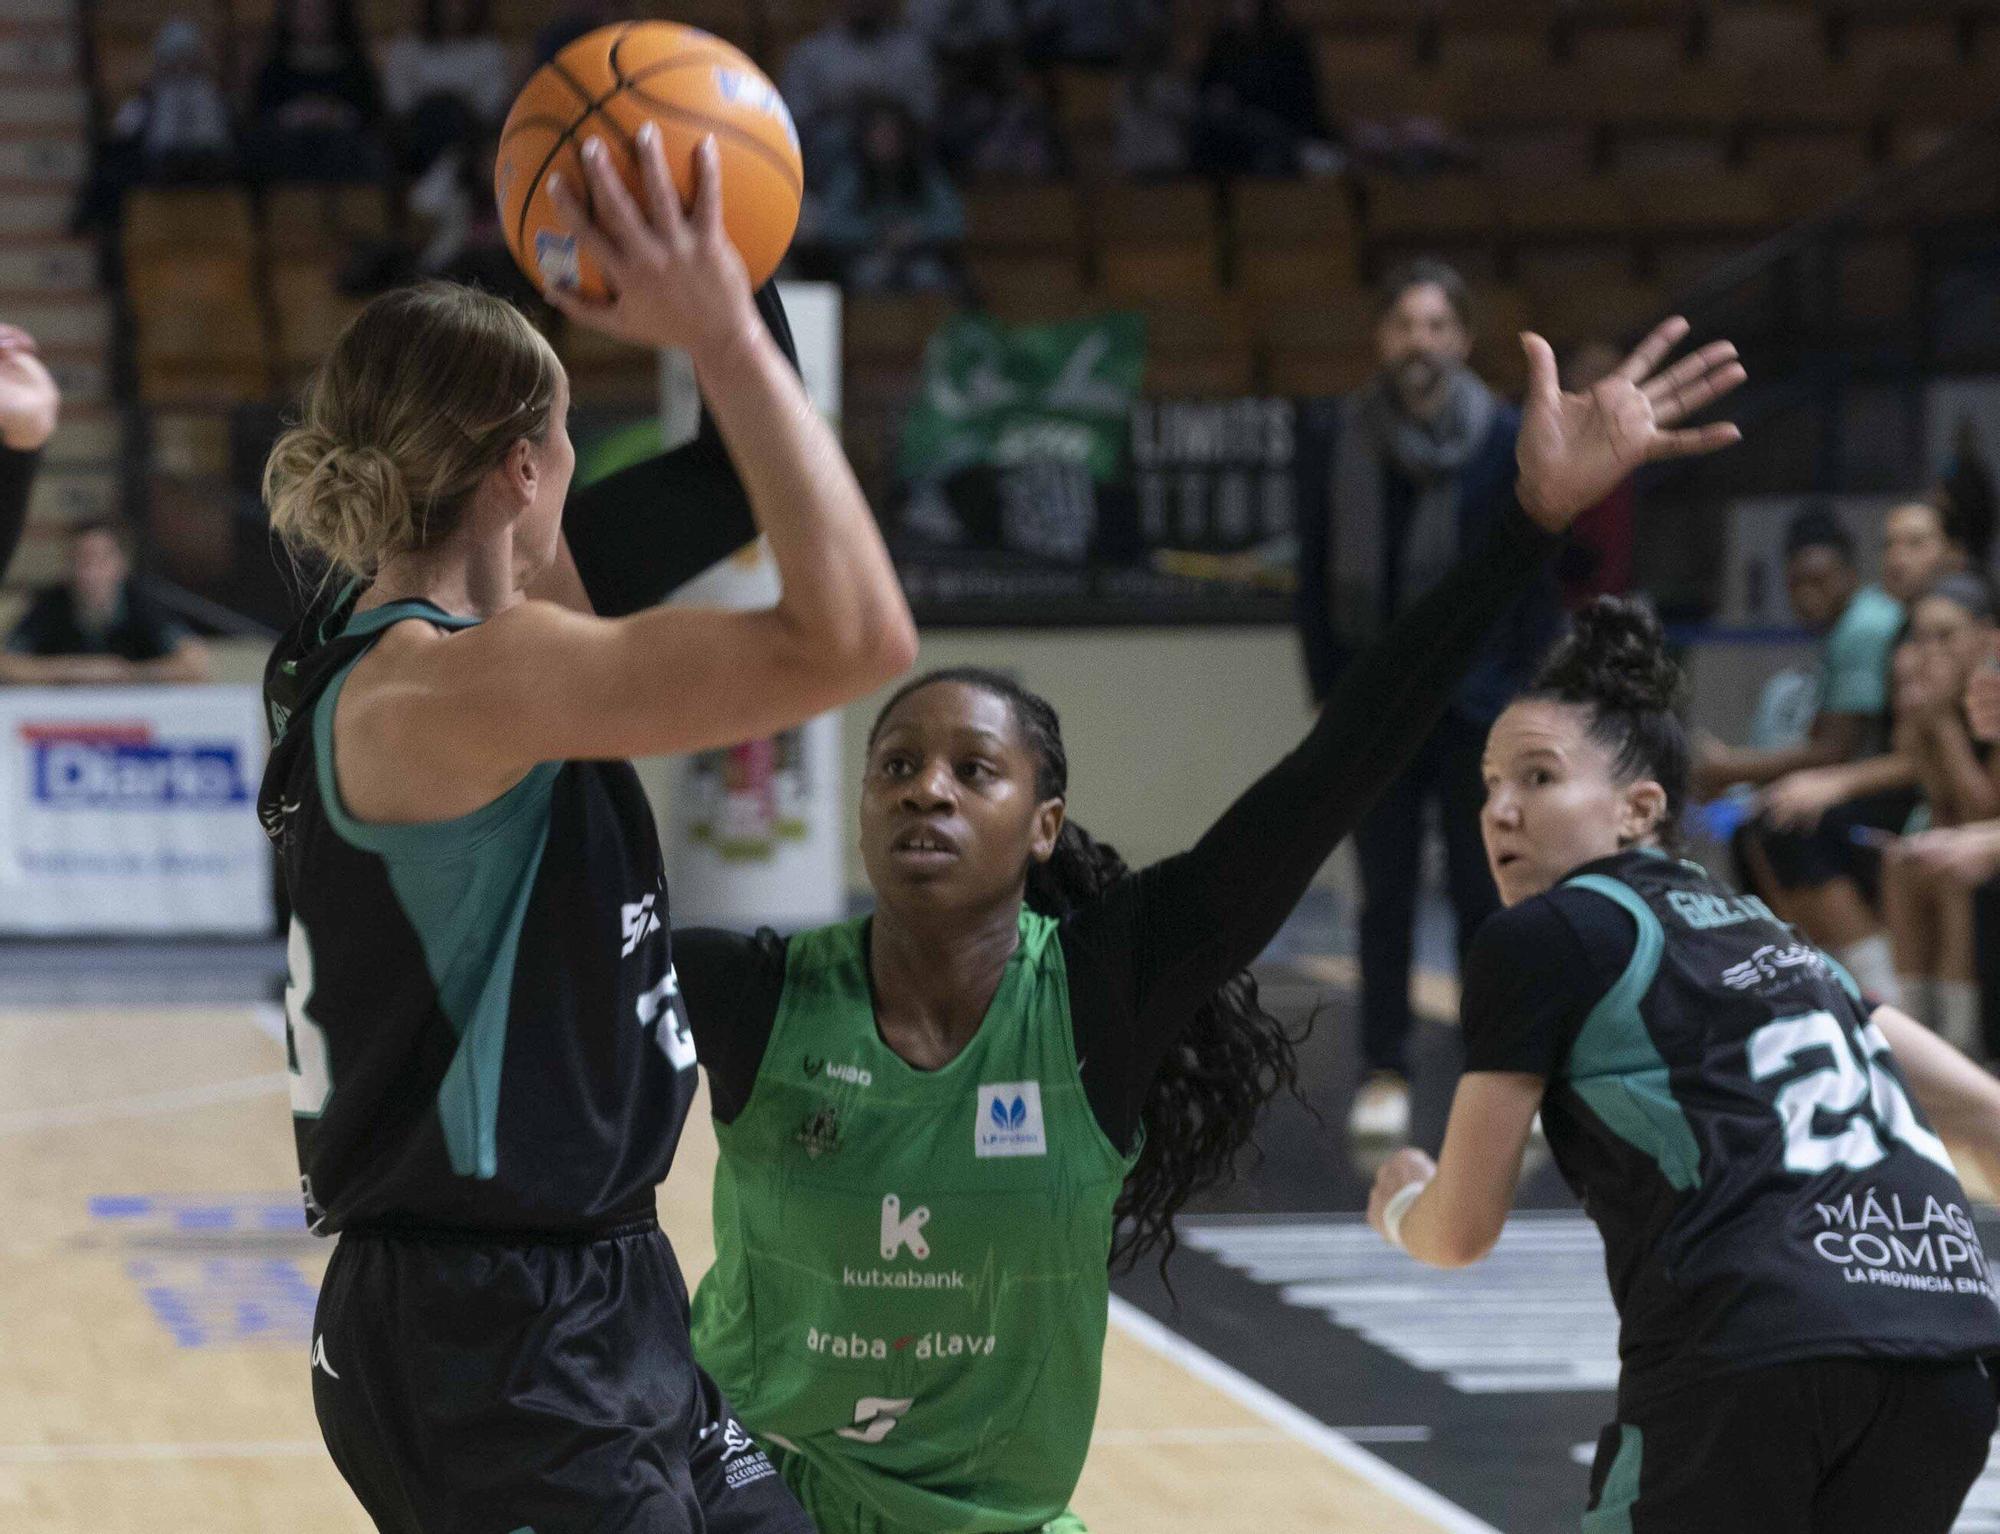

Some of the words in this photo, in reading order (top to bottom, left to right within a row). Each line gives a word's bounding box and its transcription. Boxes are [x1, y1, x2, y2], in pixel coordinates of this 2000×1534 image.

[1814, 1186, 1979, 1241] MÁLAG
[843, 1264, 964, 1289] kutxabank
[1843, 1267, 1868, 1284] LA
[1868, 1268, 1953, 1293] PROVINCIA
[807, 1326, 887, 1360] araba
[915, 1331, 996, 1360] álava
